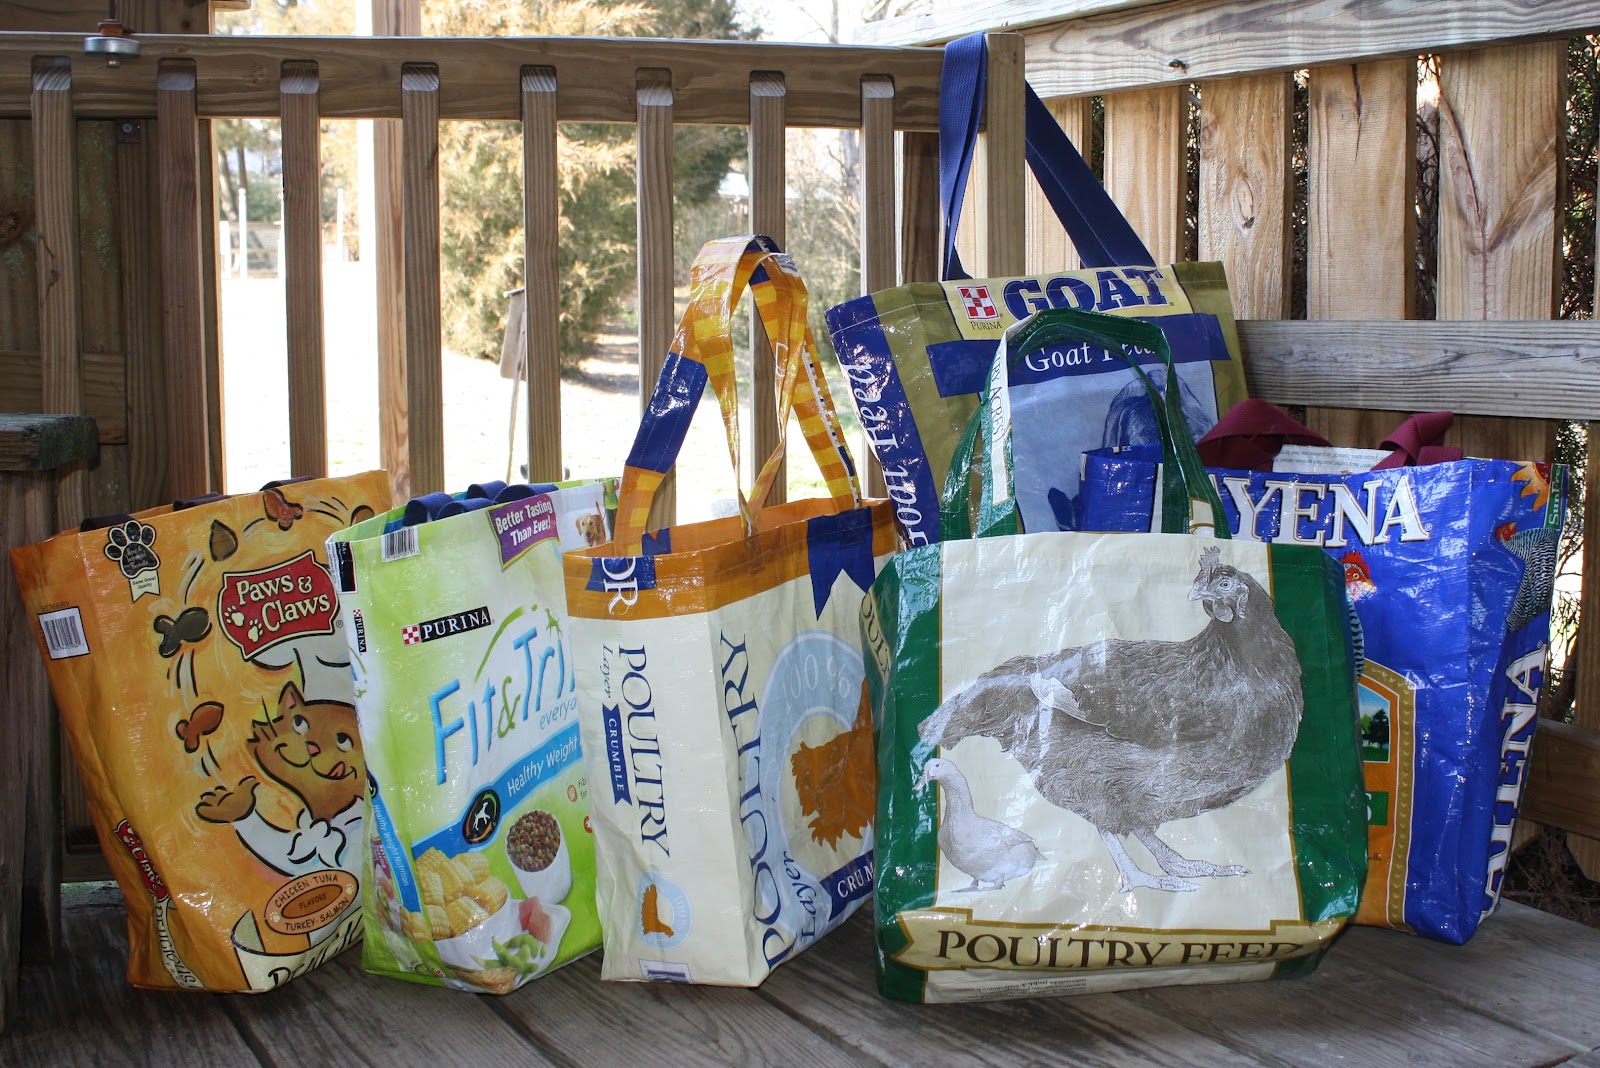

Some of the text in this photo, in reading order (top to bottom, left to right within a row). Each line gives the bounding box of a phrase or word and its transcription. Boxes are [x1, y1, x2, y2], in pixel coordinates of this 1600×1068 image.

[1003, 268, 1169, 320] GOAT
[971, 320, 1002, 331] PURINA
[1025, 342, 1092, 372] Goat
[989, 386, 1003, 435] ACRES
[495, 501, 553, 534] Better Tasting
[1209, 474, 1430, 548] YENA
[510, 516, 551, 546] Than Ever!
[236, 575, 312, 605] Paws &
[261, 594, 331, 632] Claws
[422, 609, 490, 640] PURINA
[355, 618, 366, 651] PURINA
[600, 643, 613, 699] Layer
[508, 735, 578, 797] Healthy Weight
[608, 718, 625, 792] CRUMBLE
[618, 644, 671, 858] POULTRY
[373, 804, 387, 831] Healthy
[383, 831, 397, 856] Weight
[394, 854, 409, 886] Nutrition
[274, 874, 338, 908] CHICKEN TUNA
[298, 893, 327, 909] FLAVORS
[783, 851, 817, 941] Layer
[285, 899, 349, 931] TURKEY SALMON
[934, 930, 1170, 967] POULTRY
